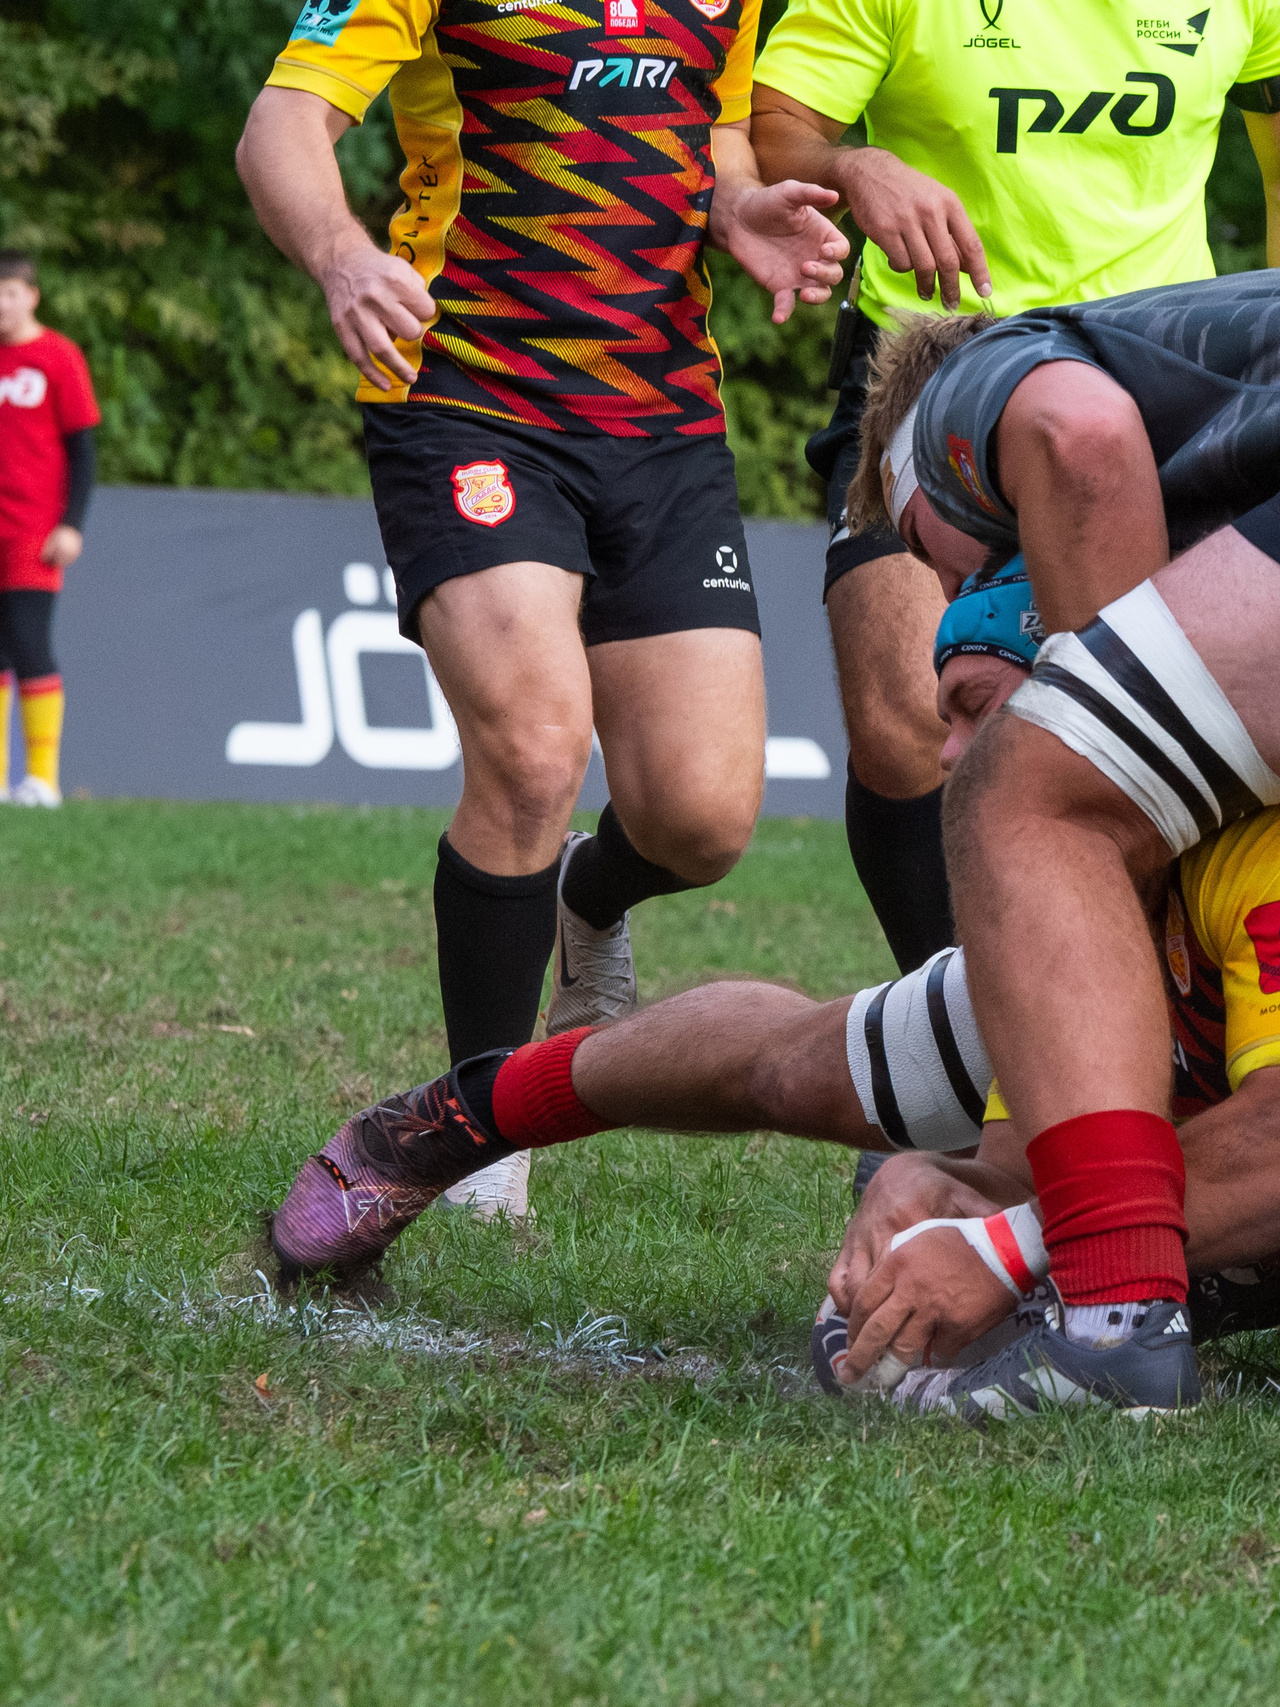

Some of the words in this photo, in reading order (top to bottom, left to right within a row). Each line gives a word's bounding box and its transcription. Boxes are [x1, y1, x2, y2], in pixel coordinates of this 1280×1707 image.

[610, 18, 638, 28] ПОБЕДА!
[1136, 19, 1170, 29] РЕГБИ
[1136, 29, 1181, 39] РОССИИ
[963, 34, 1021, 49] JÖGEL
[569, 57, 678, 90] PARI
[702, 577, 751, 592] centurion
